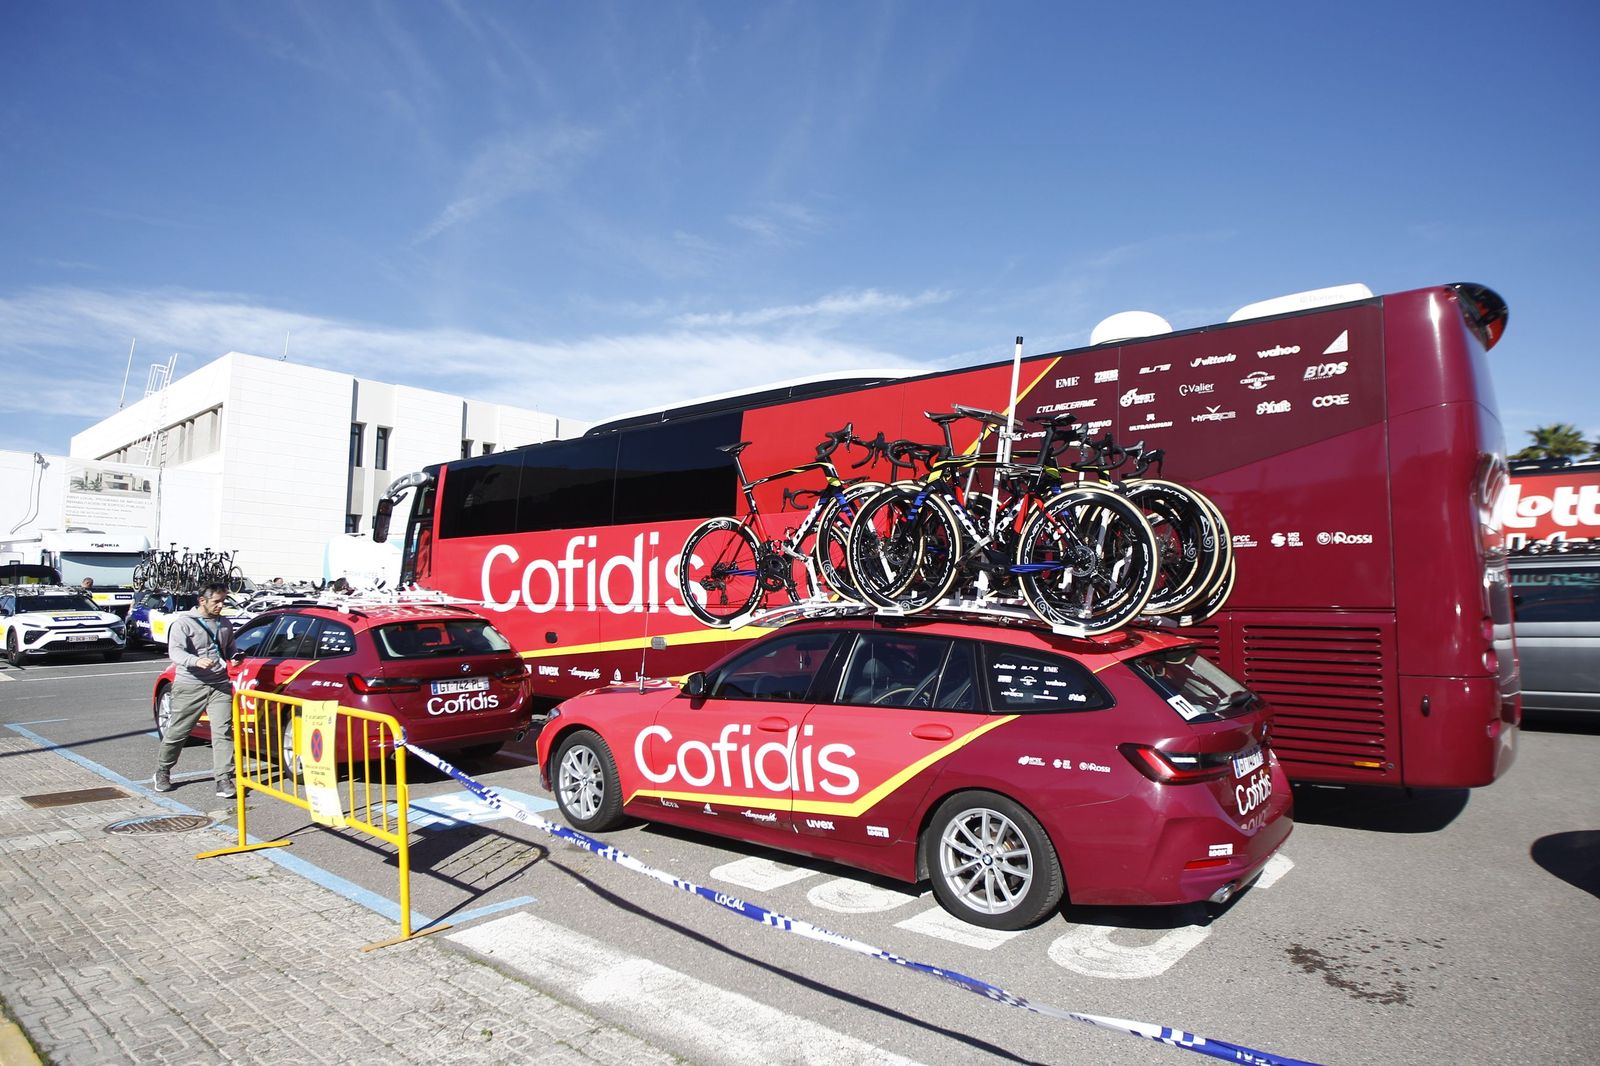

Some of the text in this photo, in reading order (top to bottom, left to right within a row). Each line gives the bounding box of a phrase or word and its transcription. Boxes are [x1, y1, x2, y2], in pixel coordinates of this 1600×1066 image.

[1257, 344, 1301, 359] wahoo
[1188, 382, 1215, 393] Valier
[1312, 393, 1350, 408] CORE
[481, 531, 708, 617] Cofidis
[426, 692, 499, 716] Cofidis
[634, 724, 860, 796] Cofidis
[1235, 769, 1272, 816] Cofidis
[806, 818, 836, 831] uvex
[714, 892, 746, 912] LOCAL
